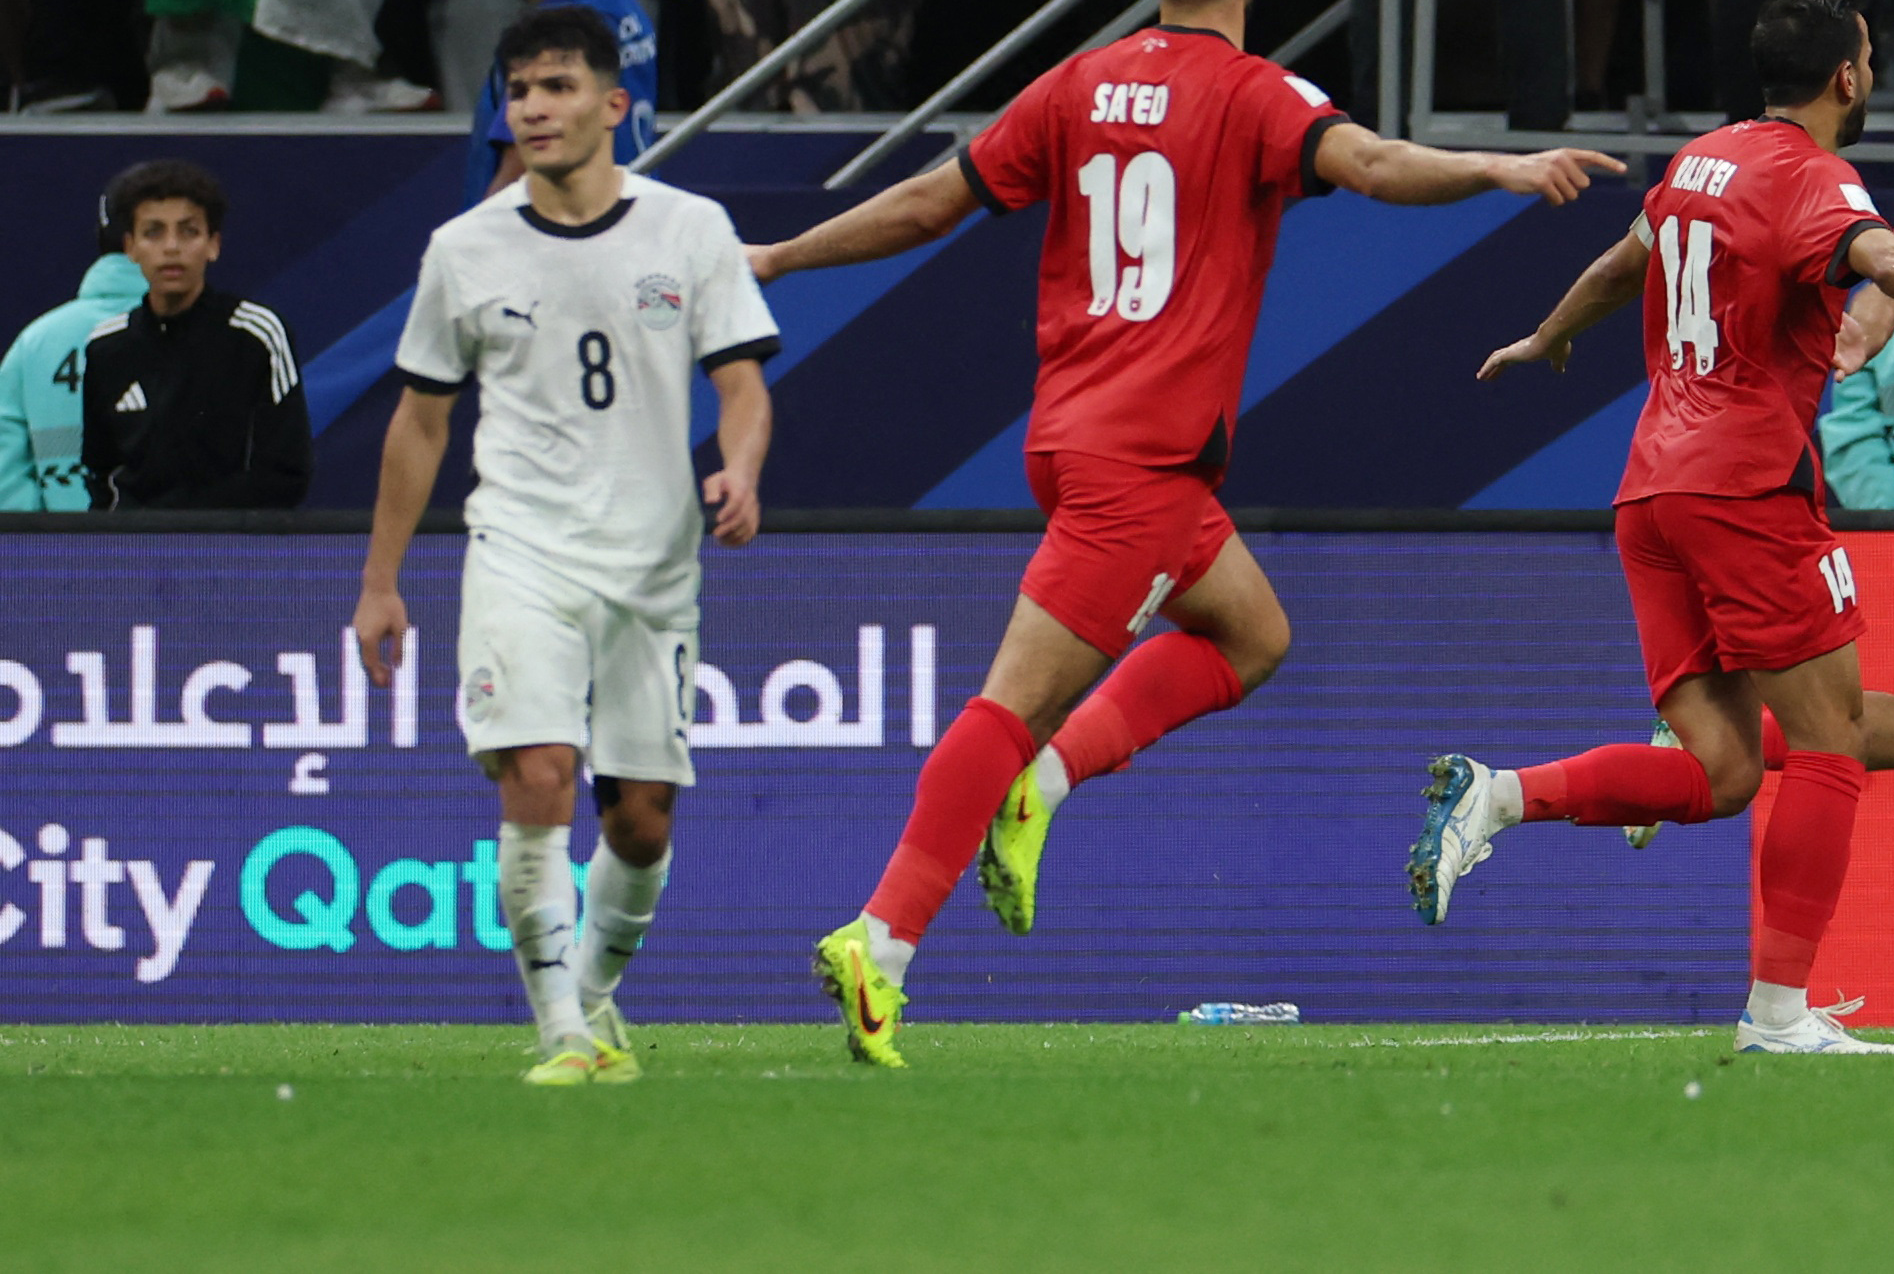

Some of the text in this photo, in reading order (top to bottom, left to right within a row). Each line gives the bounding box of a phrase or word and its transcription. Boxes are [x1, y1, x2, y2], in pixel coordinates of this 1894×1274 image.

[1090, 82, 1170, 125] SA'ED
[1671, 155, 1738, 198] RAJA'EI
[1078, 151, 1176, 322] 19
[1659, 214, 1719, 377] 14
[578, 330, 615, 410] 8
[1817, 546, 1857, 614] 14
[0, 823, 669, 984] ity Qat
